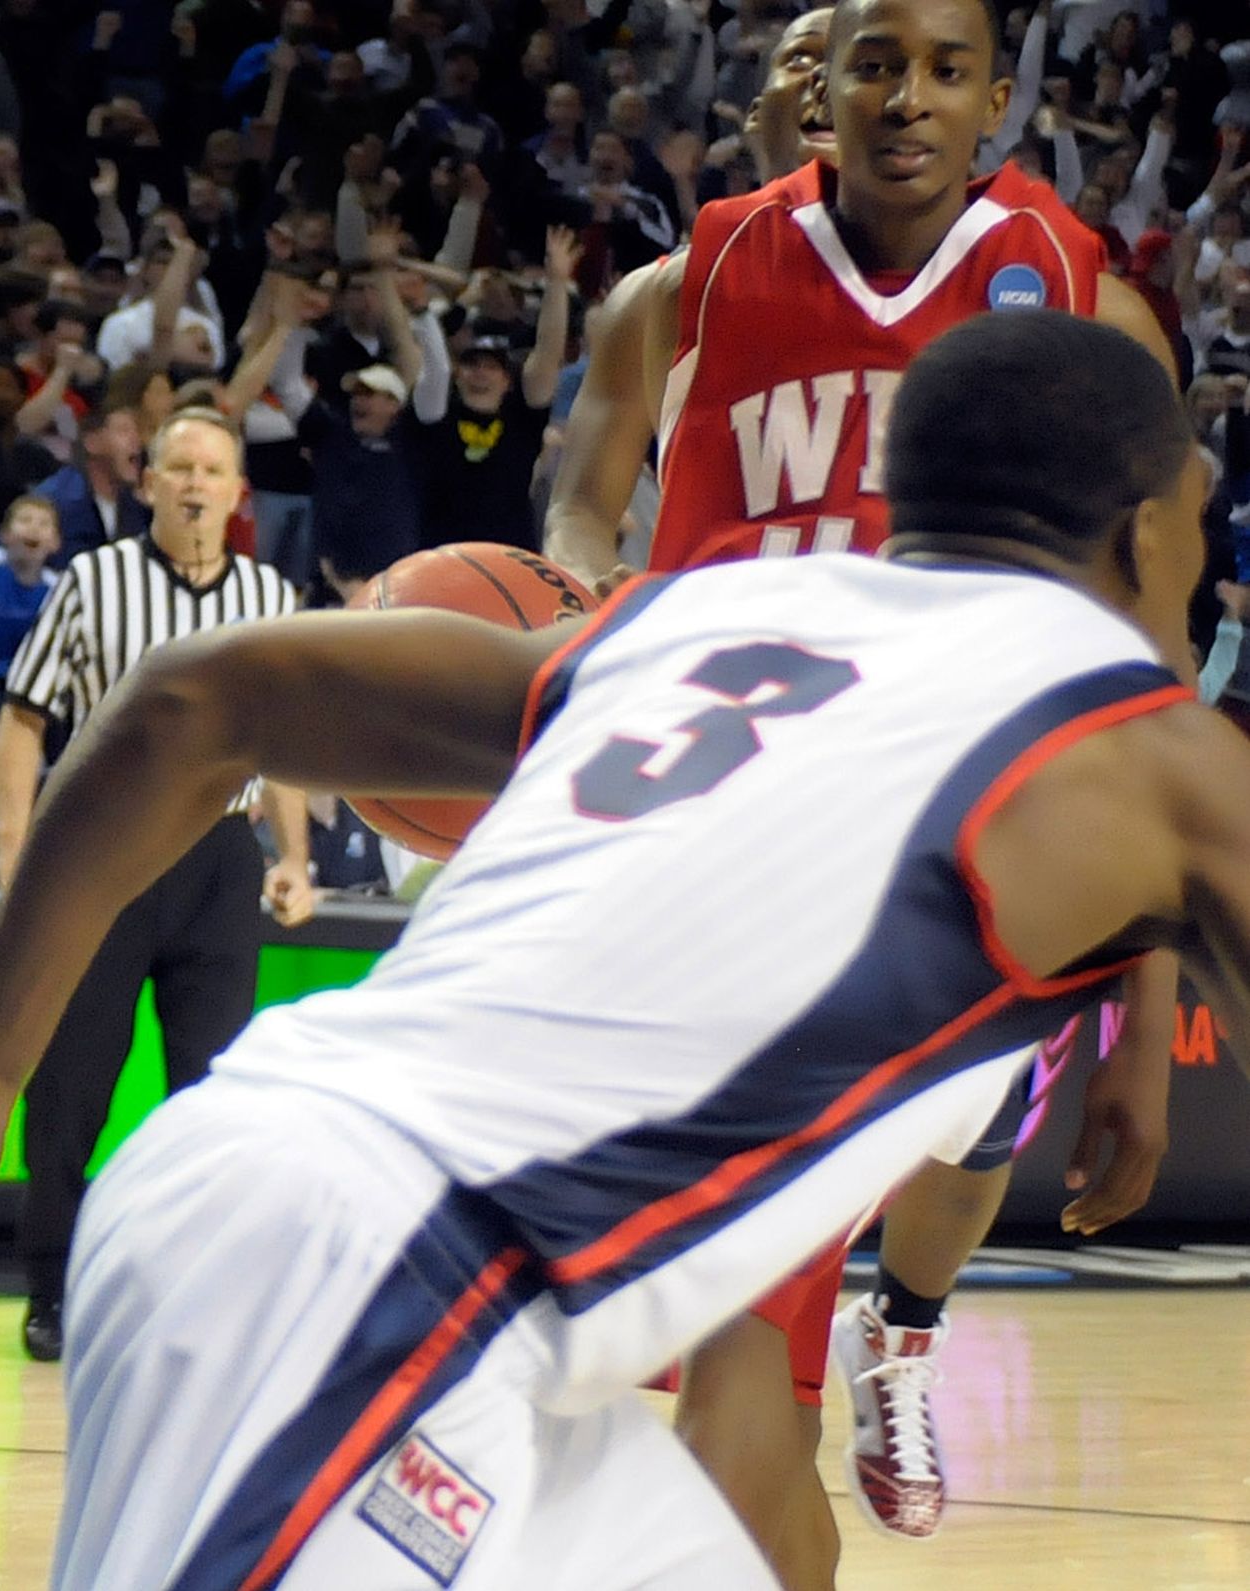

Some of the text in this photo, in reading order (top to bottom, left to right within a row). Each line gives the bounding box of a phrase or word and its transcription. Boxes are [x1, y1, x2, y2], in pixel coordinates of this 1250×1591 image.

[997, 290, 1038, 305] NCAA
[570, 641, 861, 822] 3
[396, 1442, 482, 1538] WCC
